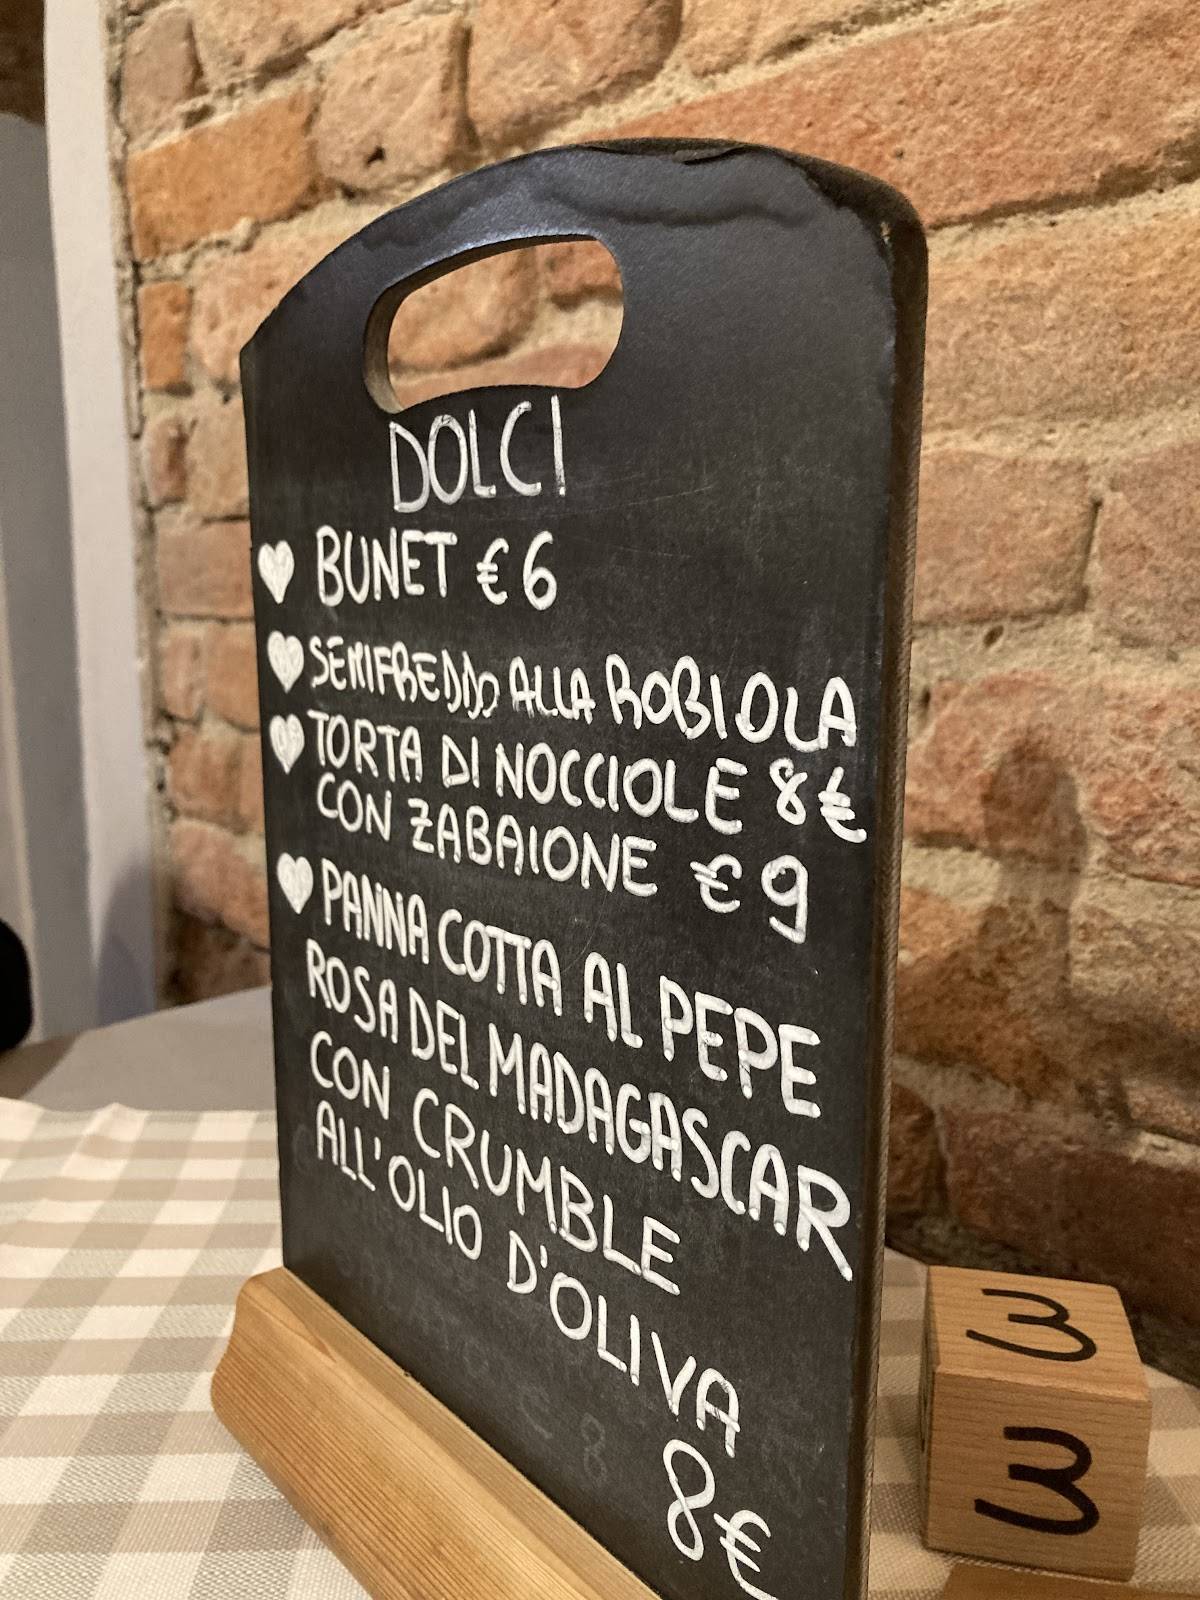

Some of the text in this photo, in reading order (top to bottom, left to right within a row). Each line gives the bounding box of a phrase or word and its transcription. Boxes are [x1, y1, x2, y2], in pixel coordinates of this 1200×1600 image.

[389, 394, 566, 513] DOLCI
[316, 525, 457, 606] BUNET
[308, 635, 858, 753] SEMIFREDDO ALLA ROBIOLA
[306, 709, 748, 835] TORTA DI NOCCIOLE
[316, 772, 392, 841] CON
[407, 797, 658, 898] ZABAIONE
[321, 858, 822, 1119] PANNA COTTA AL PEPE
[306, 938, 853, 1282] ROSA DEL MADAGASCAR
[310, 1030, 681, 1296] CON CRUMBLE
[506, 1229, 742, 1459] D'OLIVA
[966, 1288, 1097, 1362] 3
[974, 1426, 1100, 1536] 3
